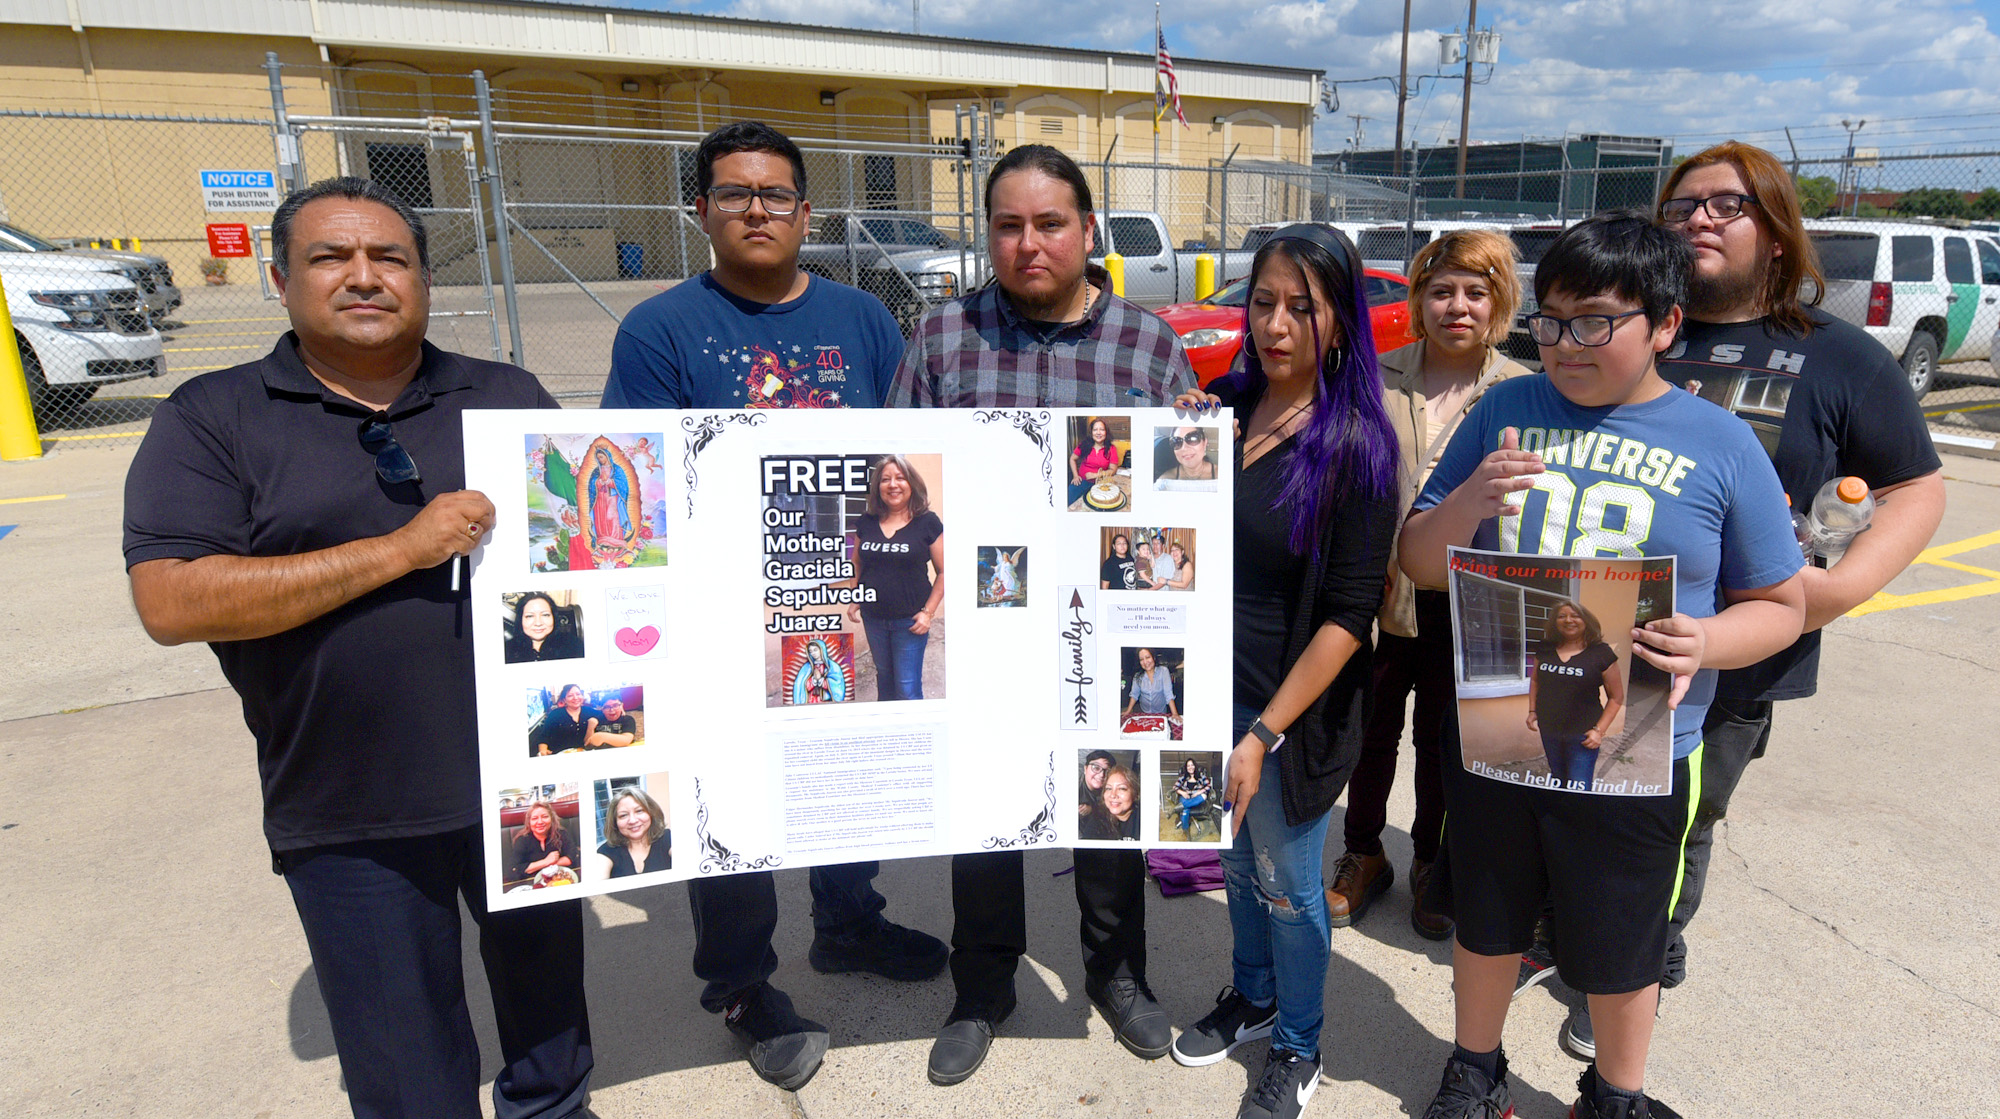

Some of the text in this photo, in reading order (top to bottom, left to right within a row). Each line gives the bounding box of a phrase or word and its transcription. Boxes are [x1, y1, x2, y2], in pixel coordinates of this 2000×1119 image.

[931, 136, 966, 147] LARE
[207, 173, 268, 186] NOTICE
[816, 350, 843, 370] 40
[763, 458, 868, 494] FREE
[764, 508, 804, 527] Our
[765, 534, 843, 553] Mother
[861, 542, 910, 553] GUESS
[765, 559, 854, 579] Graciela
[1449, 556, 1673, 582] Bring our mom home!
[766, 585, 877, 610] Sepulveda
[766, 613, 841, 632] Juarez
[1062, 620, 1093, 685] family
[1539, 663, 1584, 677] GUESS
[1472, 760, 1662, 794] Please help us find her
